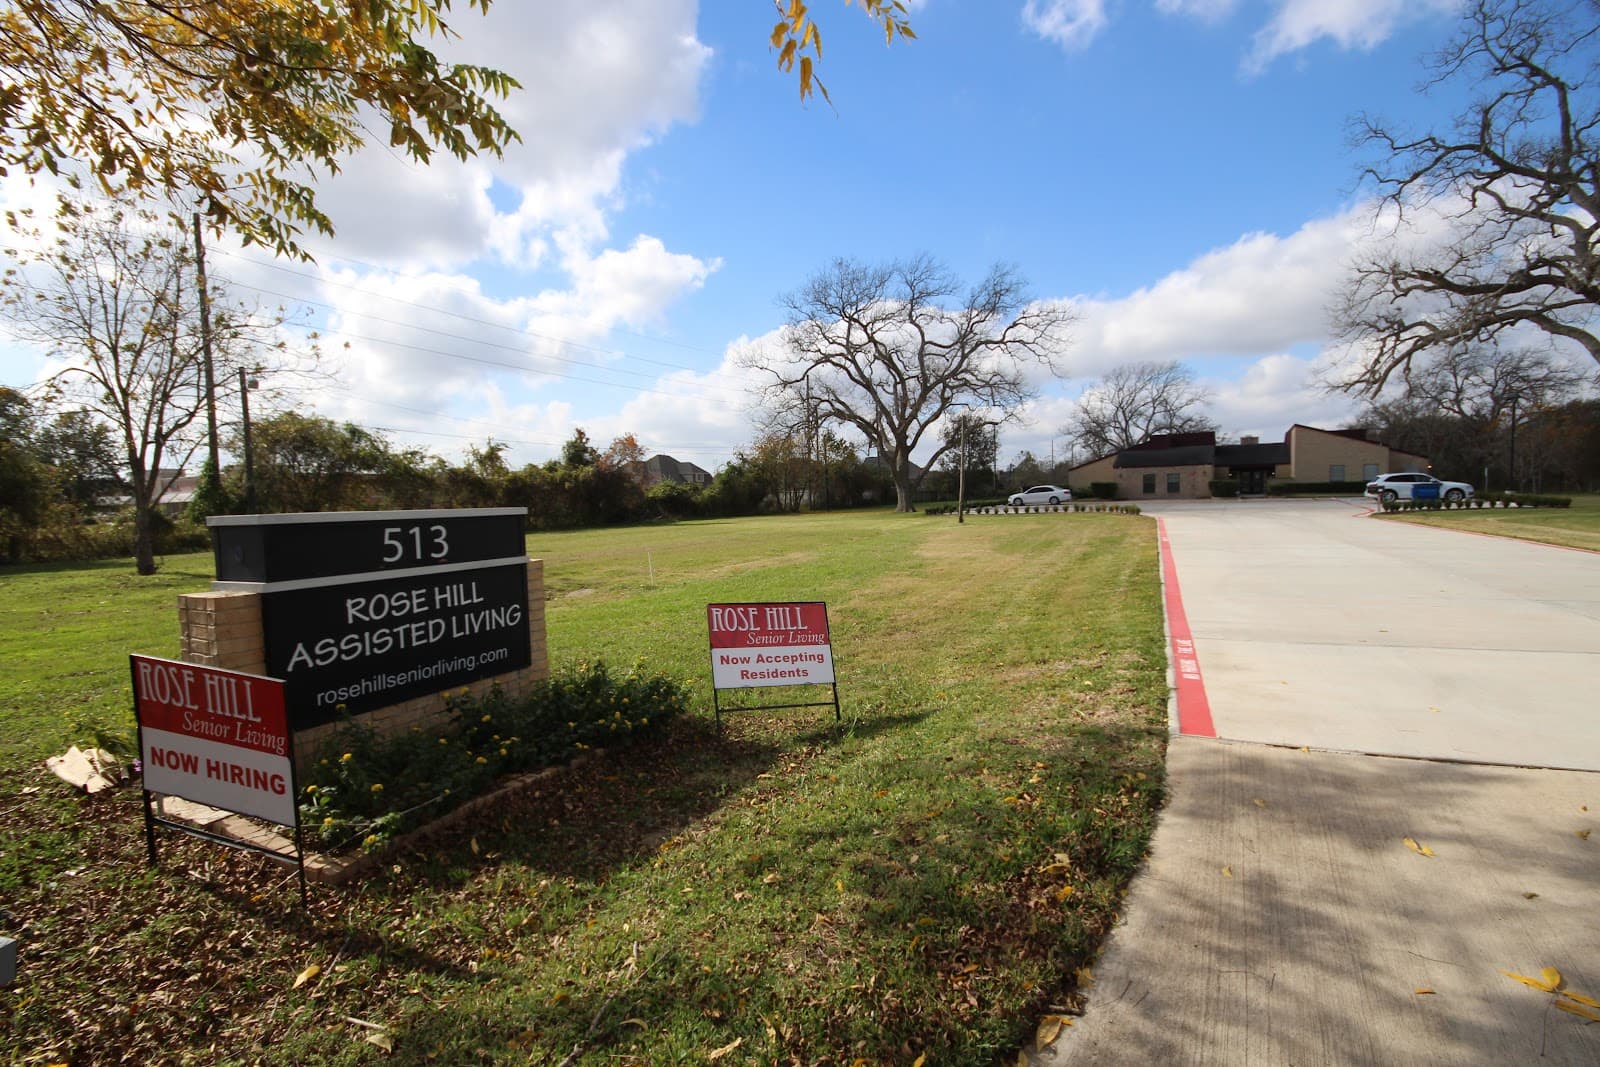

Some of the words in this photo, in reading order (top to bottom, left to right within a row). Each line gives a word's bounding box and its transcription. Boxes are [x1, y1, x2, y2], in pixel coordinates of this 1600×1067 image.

[383, 525, 449, 563] 513
[346, 588, 428, 624] ROSE
[434, 581, 484, 608] HILL
[711, 607, 760, 631] ROSE
[764, 607, 808, 631] HILL
[287, 618, 445, 672] ASSISTED
[452, 604, 522, 635] LIVING
[720, 655, 751, 665] Now
[756, 651, 825, 664] Accepting
[747, 631, 785, 644] Senior
[788, 631, 825, 644] Living
[138, 661, 199, 710] ROSE
[203, 673, 262, 723] HILL
[317, 646, 508, 706] rosehillseniorliving.com
[740, 668, 809, 680] Residents
[182, 711, 231, 738] Senior
[235, 721, 286, 755] Living
[151, 746, 199, 775] NOW
[206, 758, 286, 795] HIRING
